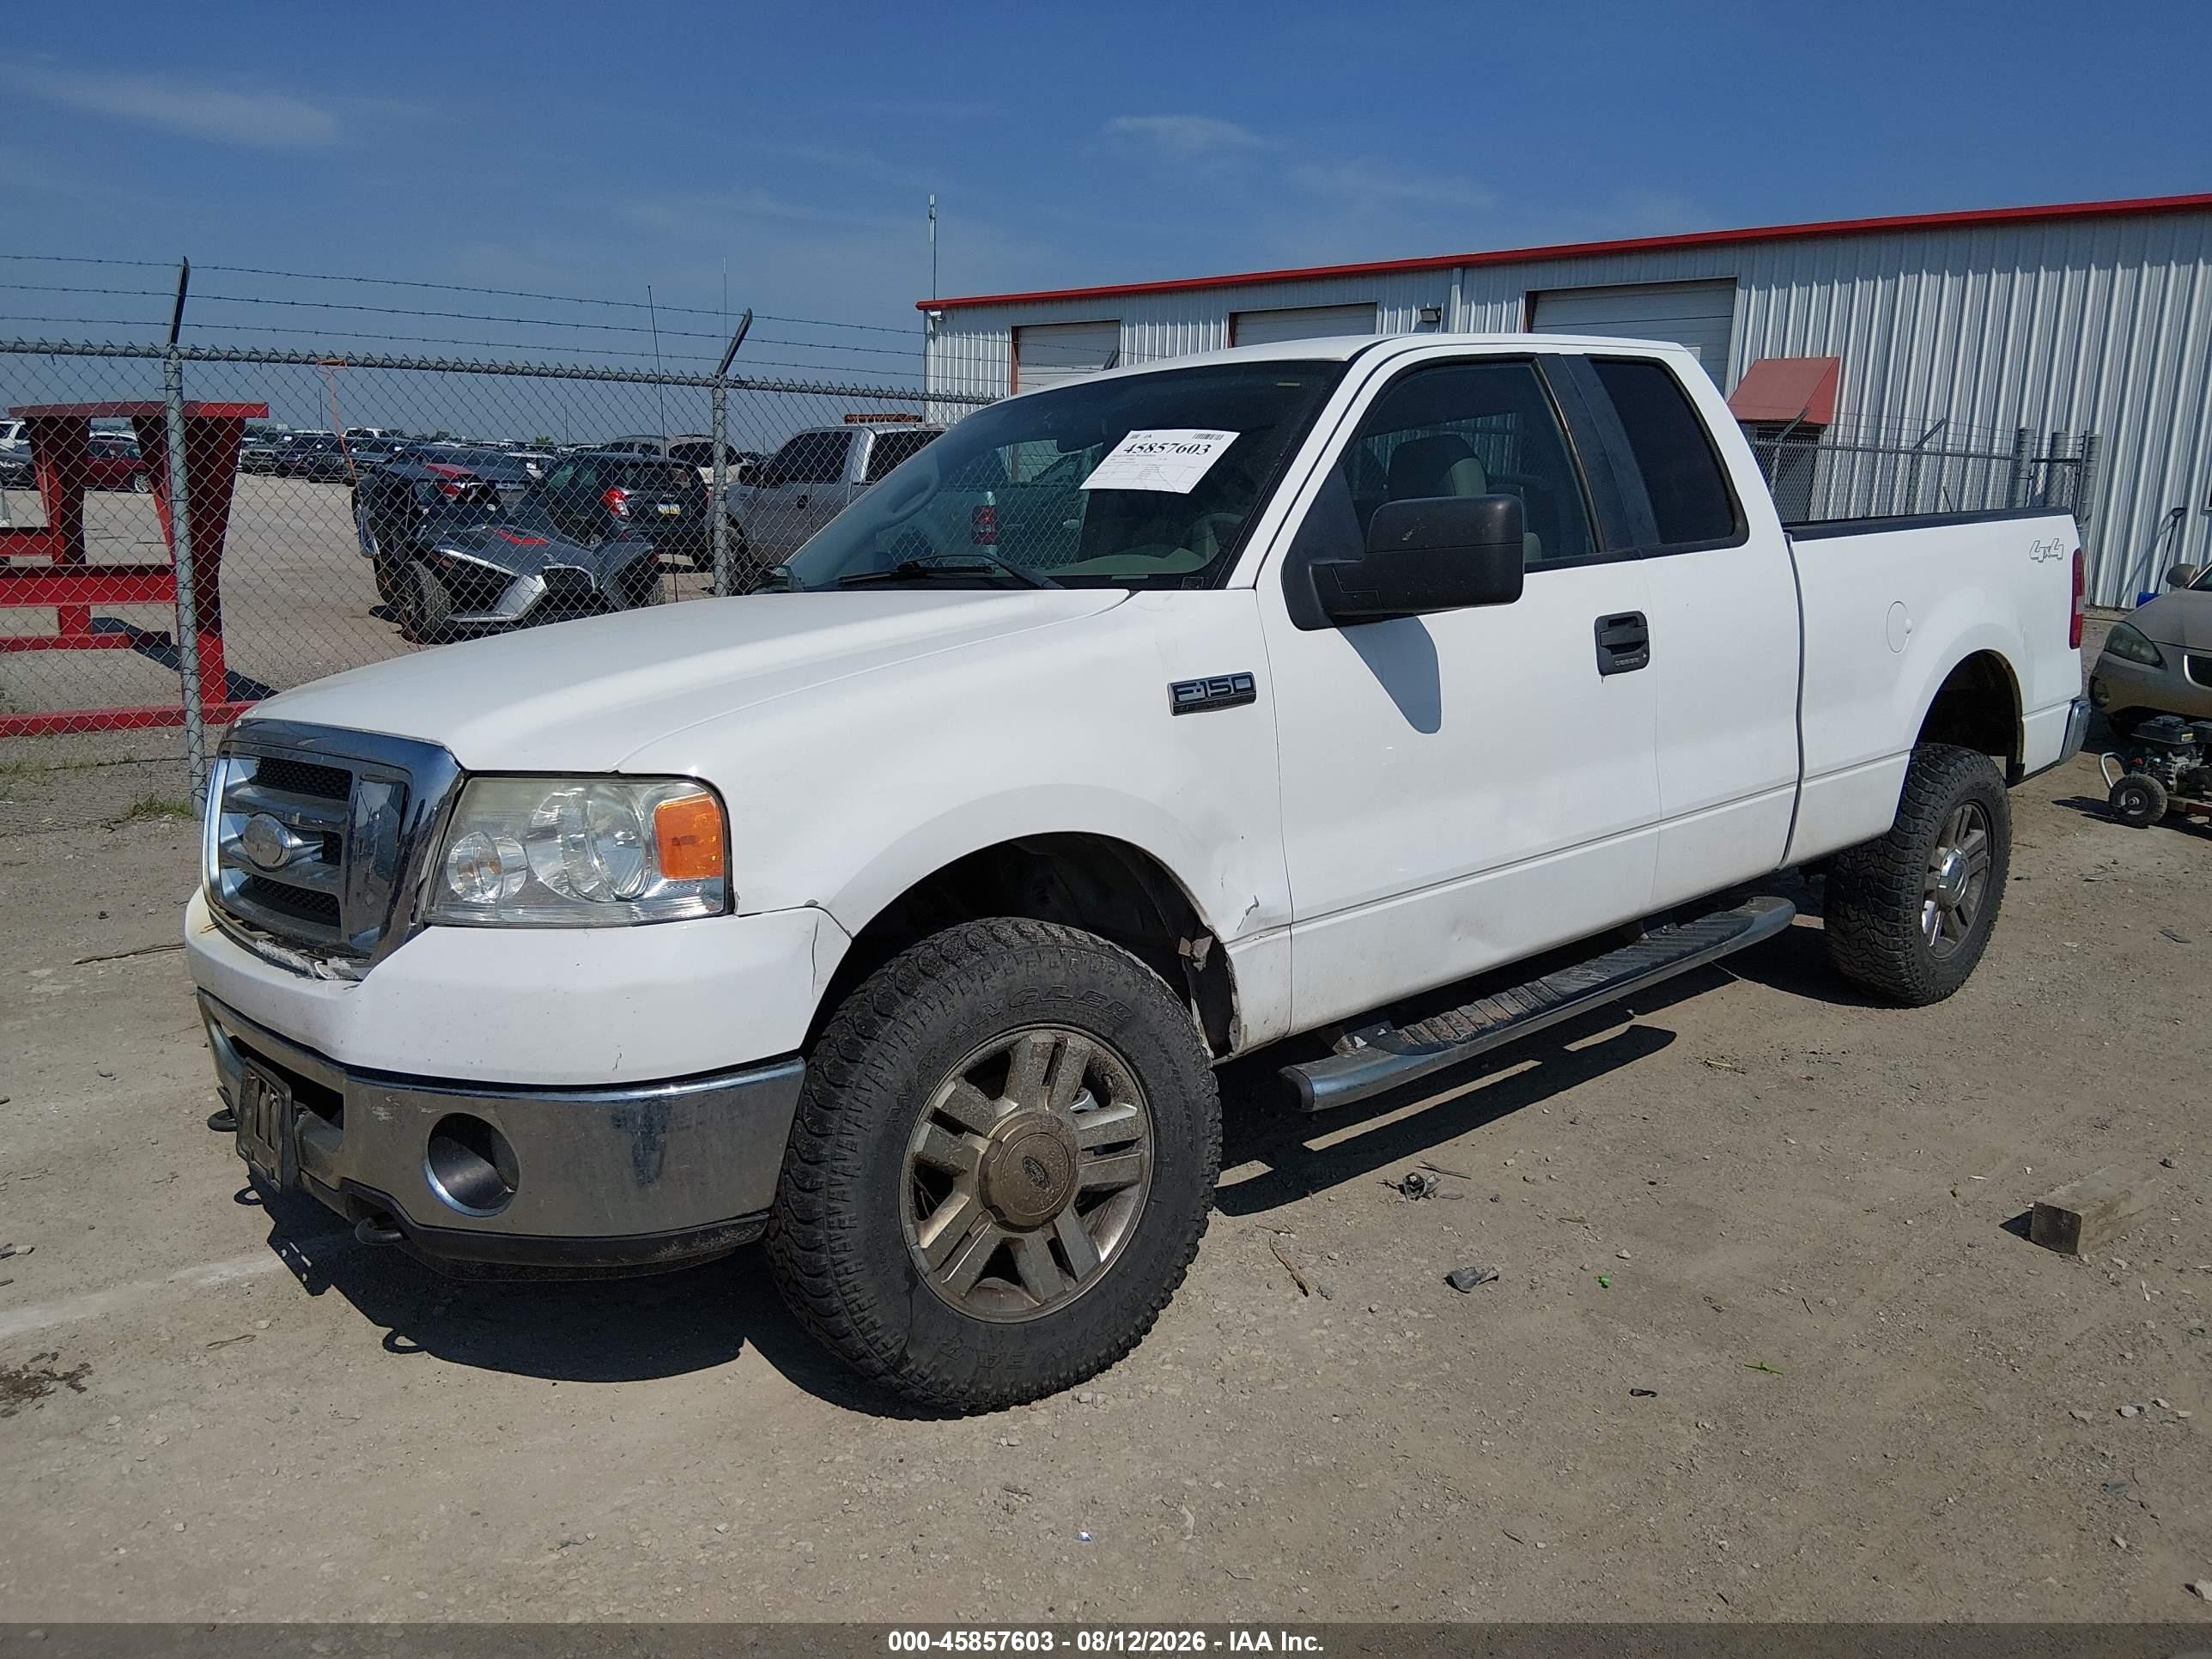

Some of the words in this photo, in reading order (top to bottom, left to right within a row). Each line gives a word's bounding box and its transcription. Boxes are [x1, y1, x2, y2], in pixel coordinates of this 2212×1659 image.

[1123, 442, 1212, 455] 45857603
[2029, 538, 2064, 563] 4x4
[1173, 674, 1255, 702] F-150
